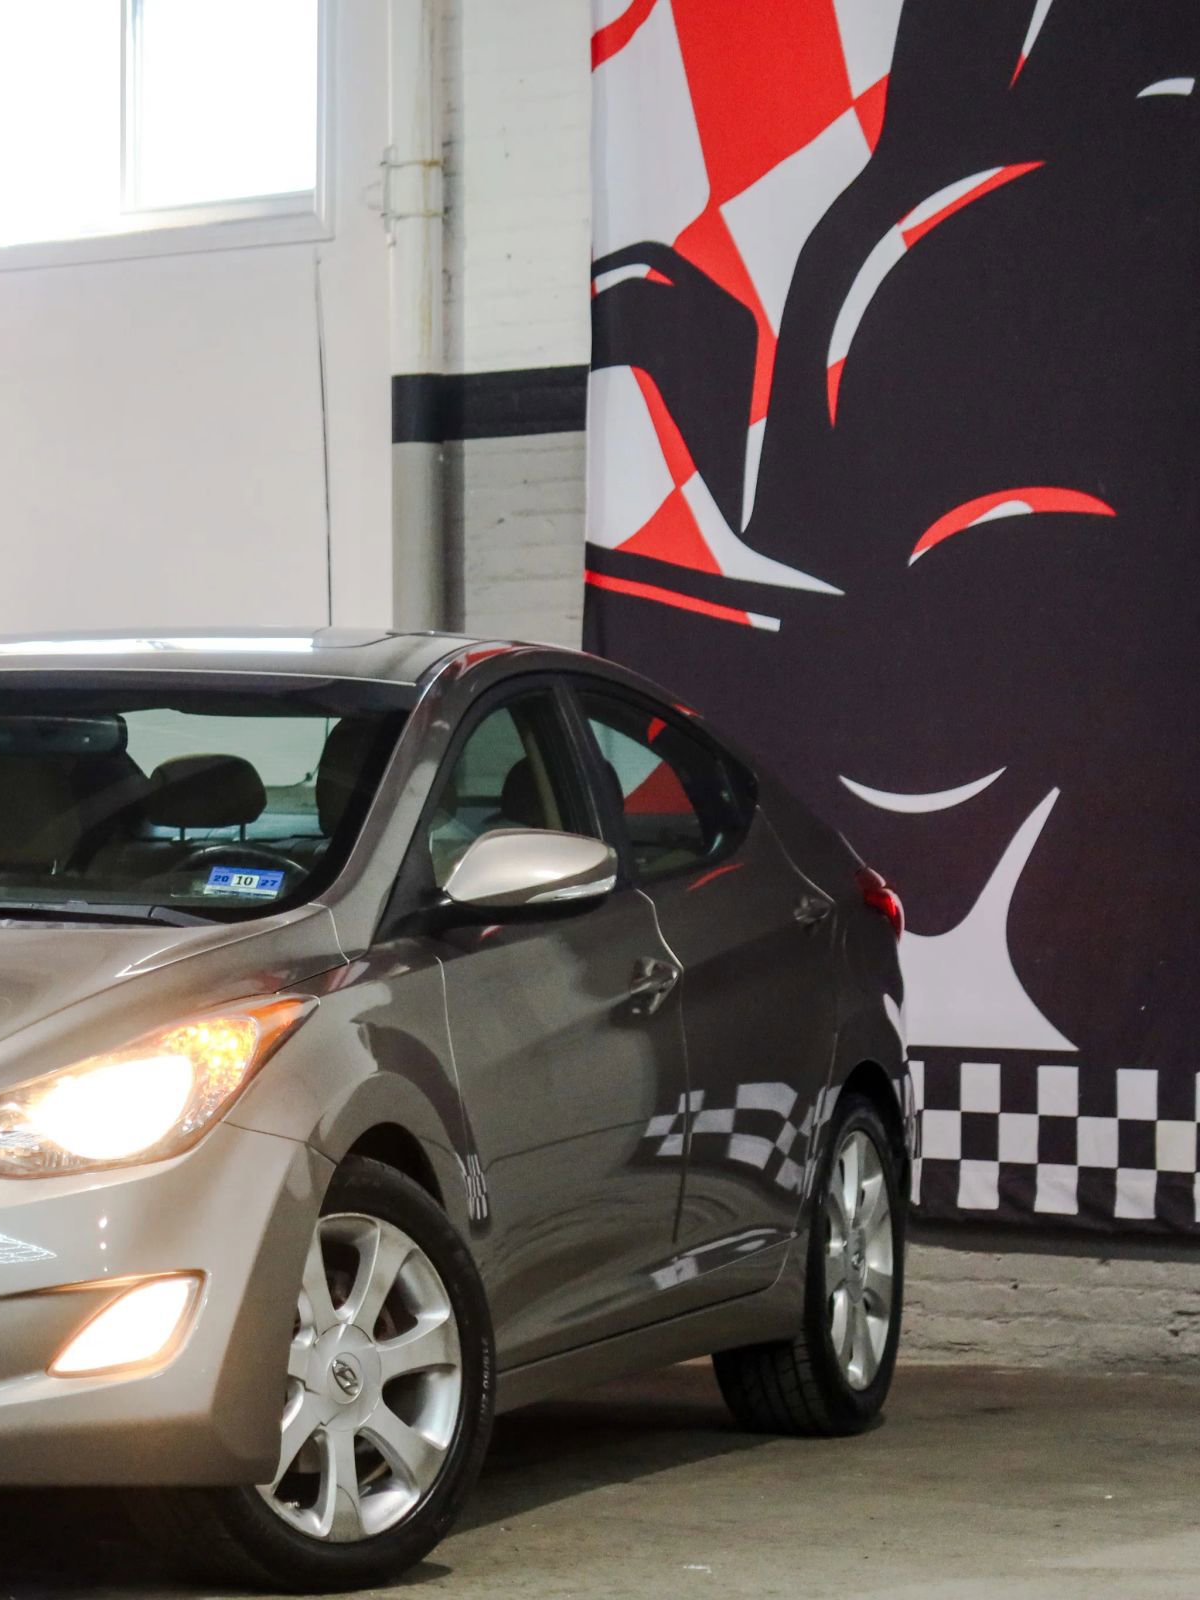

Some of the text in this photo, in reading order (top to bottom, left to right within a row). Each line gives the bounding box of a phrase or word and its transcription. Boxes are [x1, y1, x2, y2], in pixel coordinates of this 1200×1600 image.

[213, 874, 278, 887] 20 10 27
